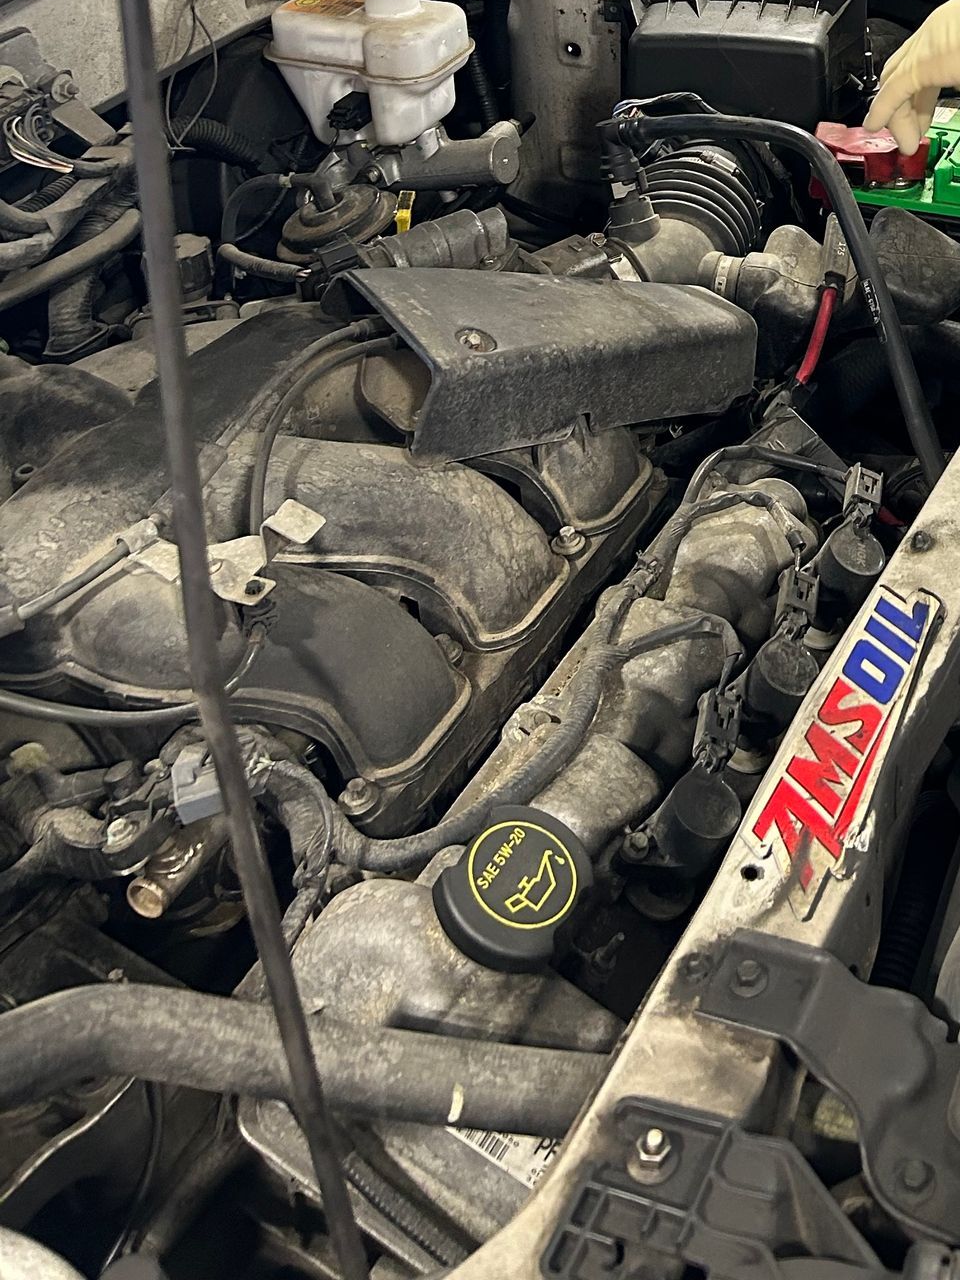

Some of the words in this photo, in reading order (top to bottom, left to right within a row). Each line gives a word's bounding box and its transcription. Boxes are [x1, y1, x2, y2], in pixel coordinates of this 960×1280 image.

[753, 593, 935, 891] AMSOIL
[476, 863, 500, 889] SAE
[493, 827, 526, 866] 5W-20
